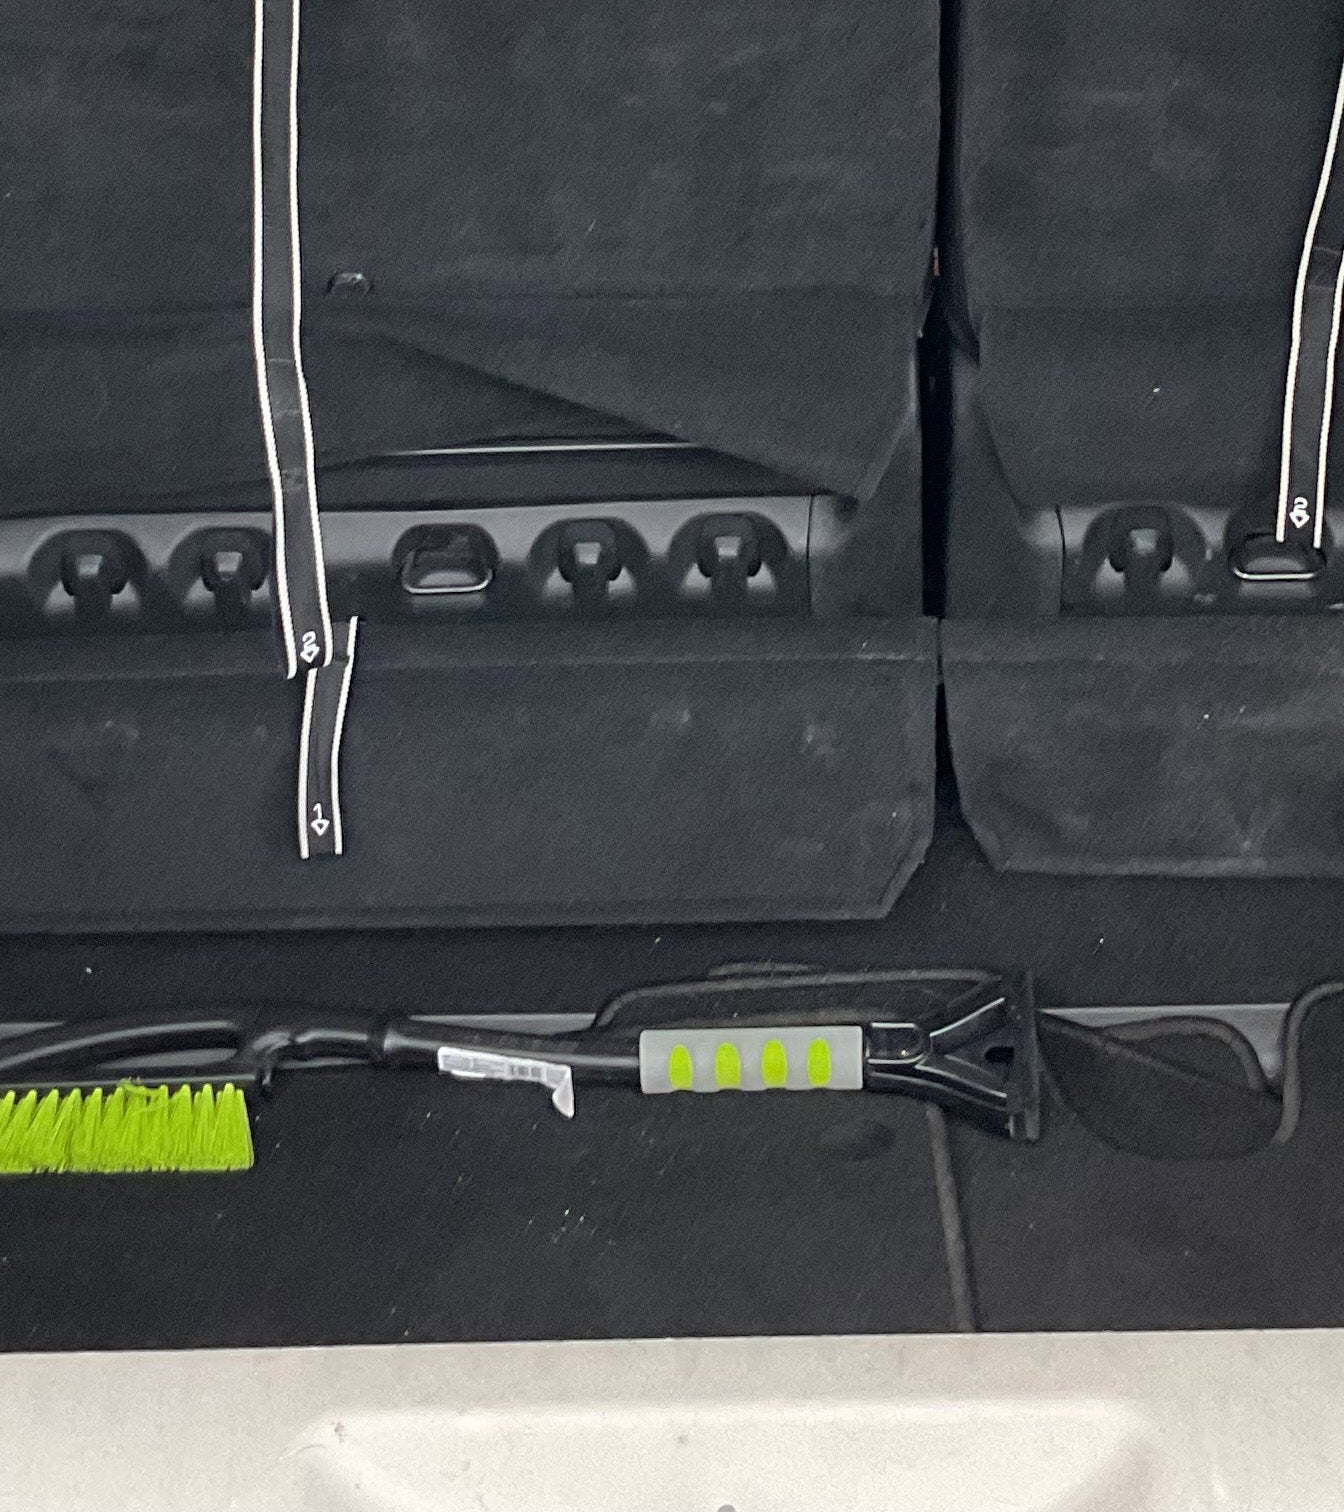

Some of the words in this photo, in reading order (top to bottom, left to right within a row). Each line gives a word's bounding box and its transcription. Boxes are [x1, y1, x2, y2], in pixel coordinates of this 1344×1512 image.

[1293, 496, 1308, 513] 2
[302, 630, 316, 650] 2
[312, 802, 323, 819] 1
